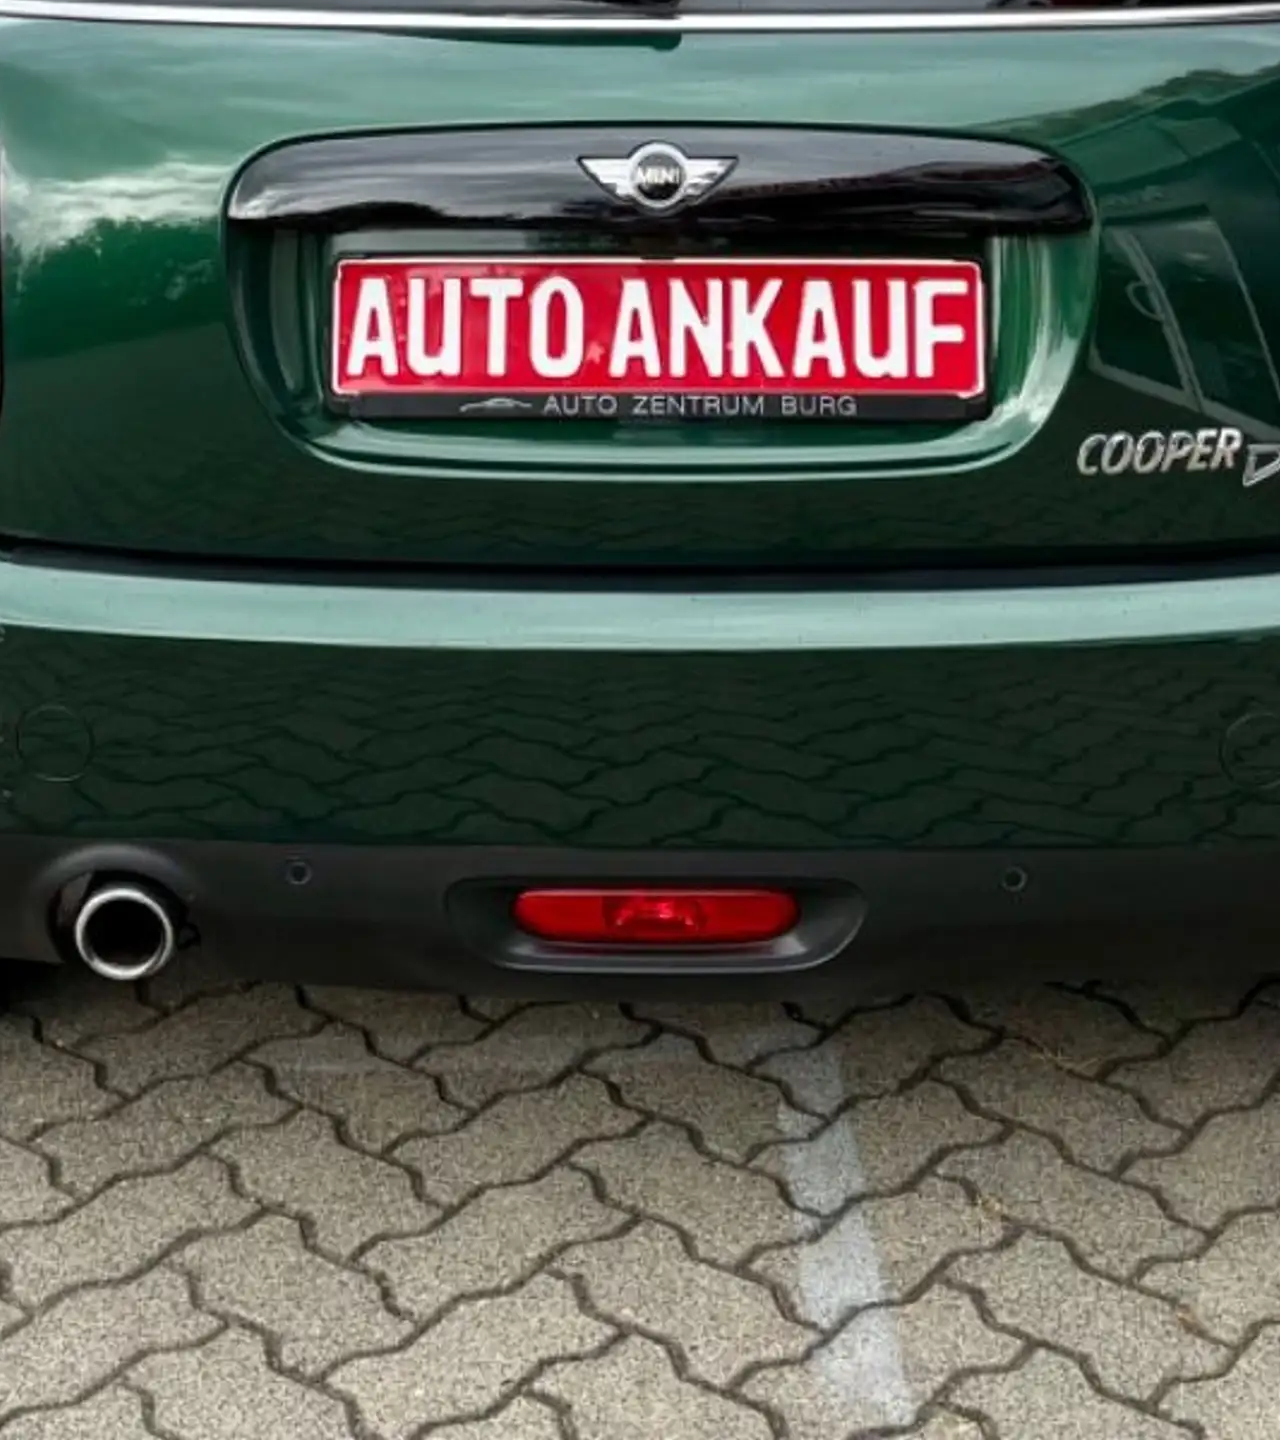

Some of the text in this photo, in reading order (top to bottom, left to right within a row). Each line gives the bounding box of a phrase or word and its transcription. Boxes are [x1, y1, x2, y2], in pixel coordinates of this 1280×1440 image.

[636, 165, 680, 185] MINI
[346, 276, 969, 378] AUTO ANKAUF
[543, 395, 858, 416] AUTO ZENTRUM BURG
[1077, 427, 1243, 476] COOPER
